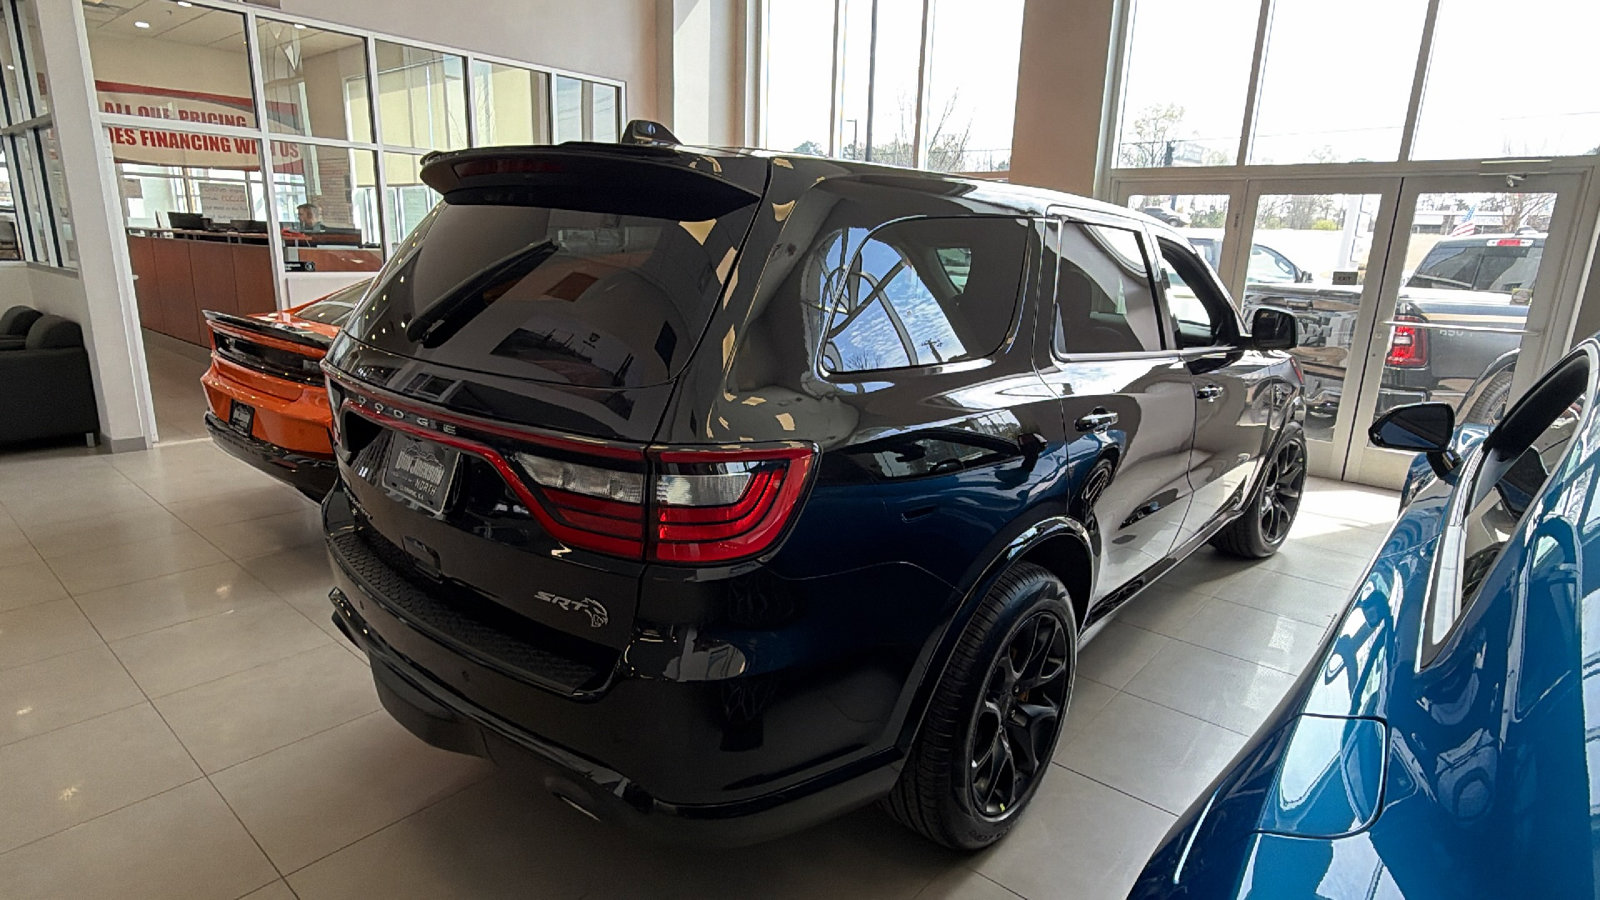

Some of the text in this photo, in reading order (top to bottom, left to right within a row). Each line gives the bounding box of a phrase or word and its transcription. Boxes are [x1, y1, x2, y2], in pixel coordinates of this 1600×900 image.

[139, 129, 231, 152] FINANCING
[279, 141, 299, 158] US
[358, 394, 457, 436] DODGE
[414, 478, 438, 496] NORTH
[534, 590, 588, 611] SRT
